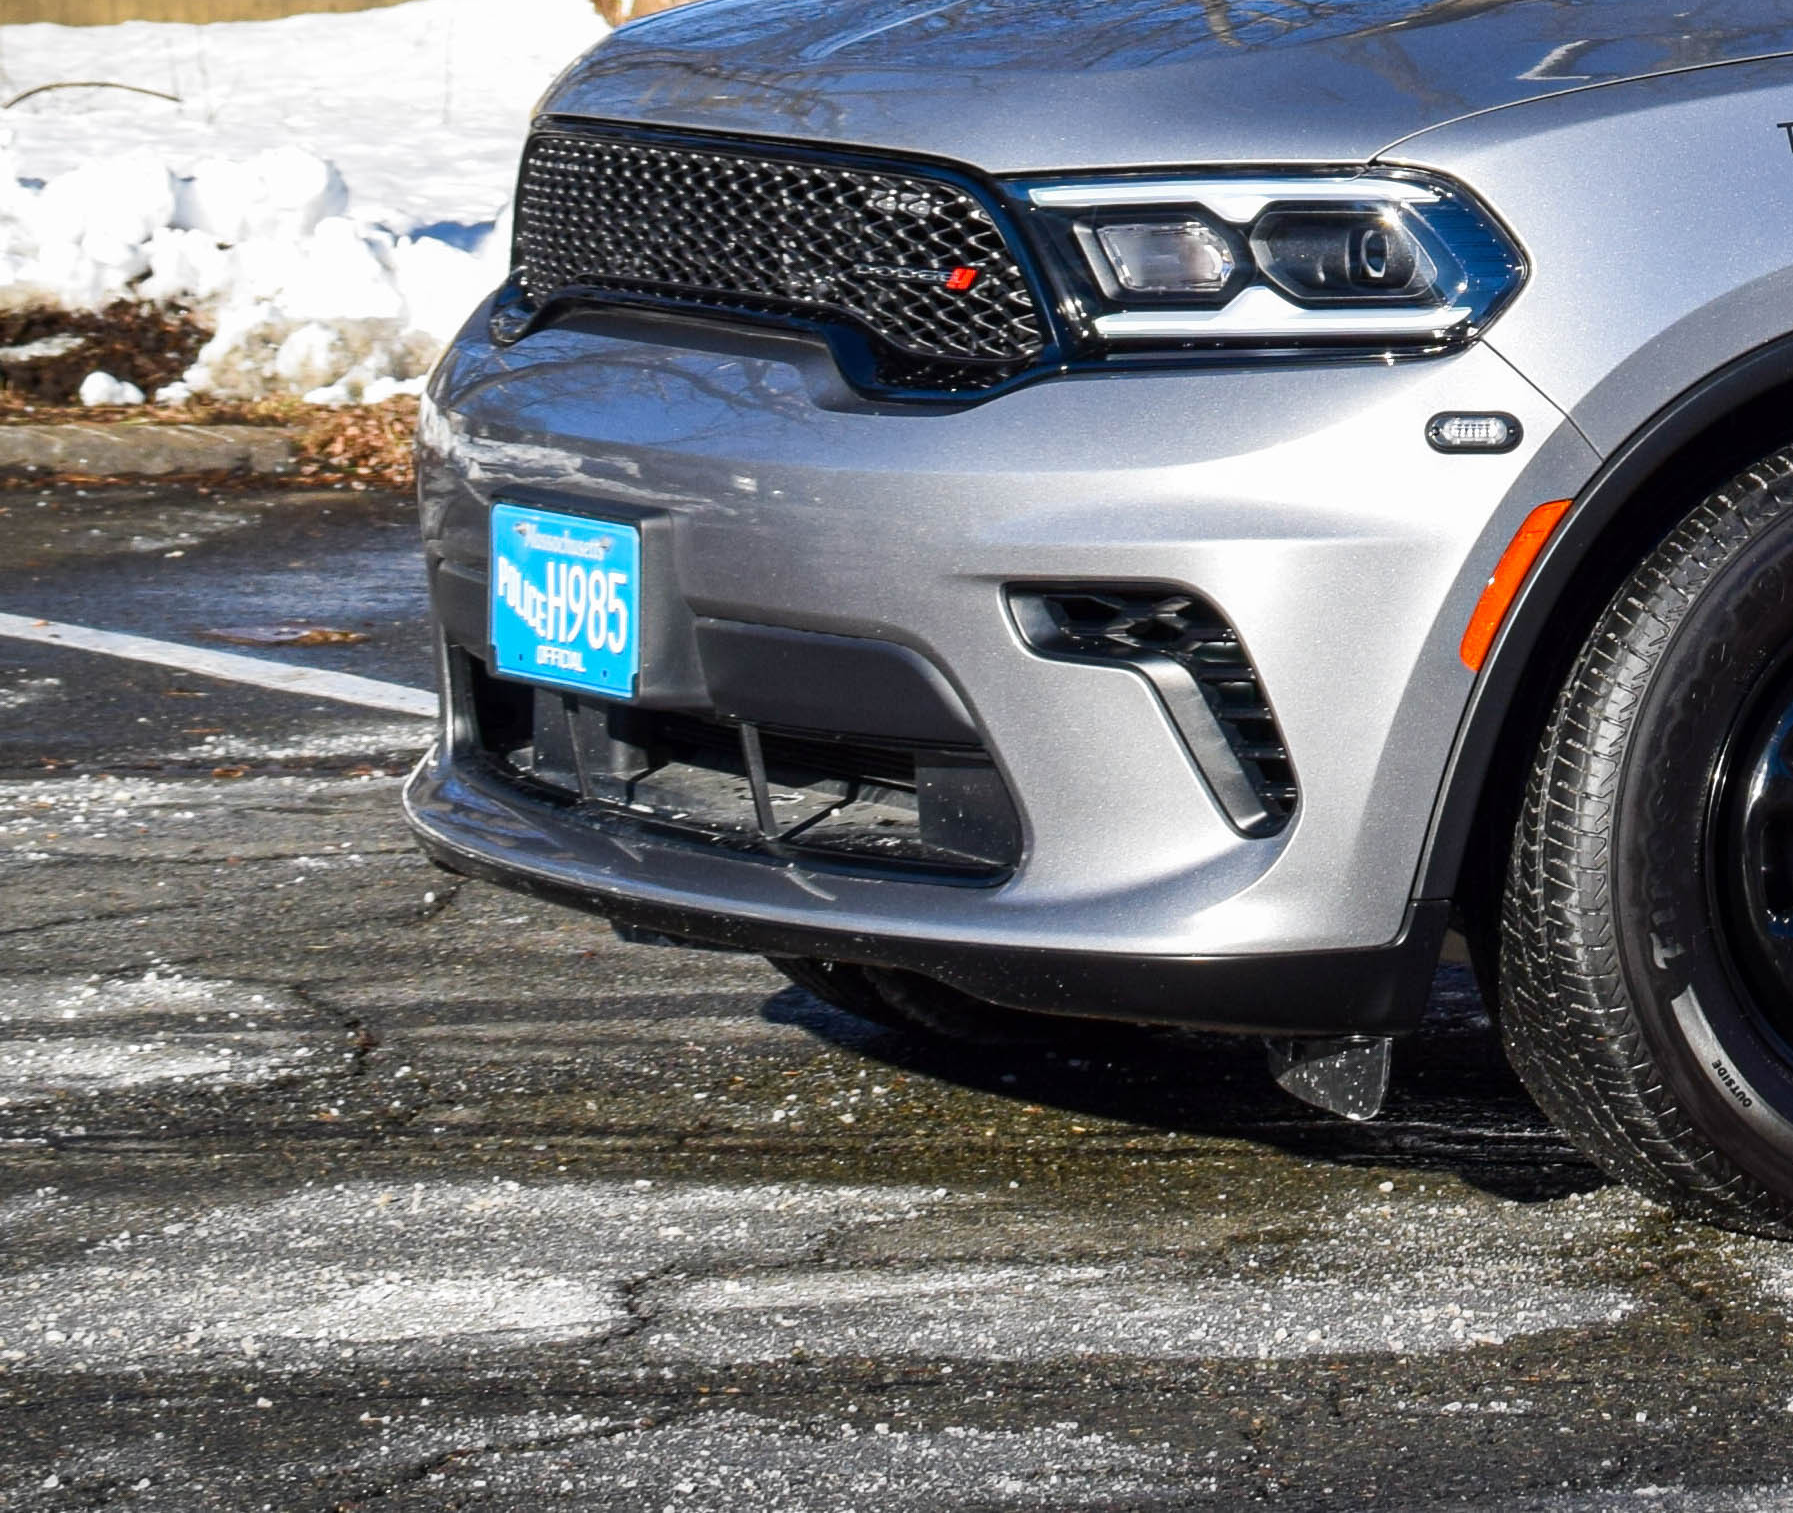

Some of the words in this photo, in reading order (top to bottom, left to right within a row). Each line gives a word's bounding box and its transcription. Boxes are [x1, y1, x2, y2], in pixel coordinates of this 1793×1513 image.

[498, 556, 547, 640] POLICE
[546, 561, 628, 655] H985
[536, 644, 587, 673] OFFICIAL
[1711, 1059, 1752, 1108] OUTSIDE
